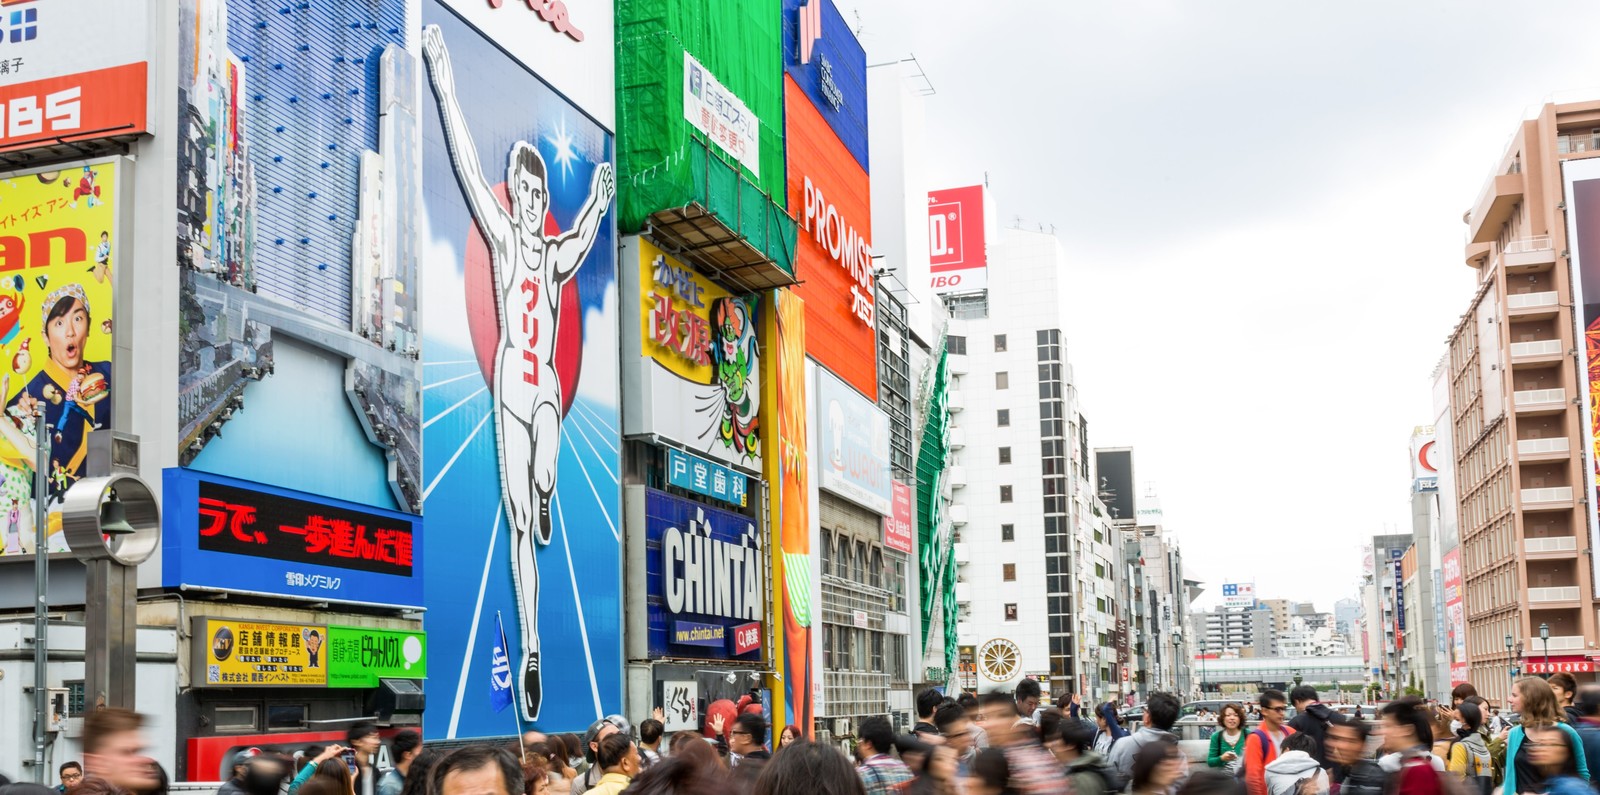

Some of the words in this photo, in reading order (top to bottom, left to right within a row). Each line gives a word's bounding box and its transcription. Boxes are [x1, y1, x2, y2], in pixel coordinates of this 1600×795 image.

[0, 86, 81, 139] BS
[804, 175, 874, 299] PROMISE
[652, 254, 705, 309] かぜに
[520, 275, 540, 387] グリコ
[648, 291, 712, 367] 改源
[674, 454, 745, 501] 戸堂歯科
[285, 571, 341, 591] 雪印メグミルク
[662, 506, 763, 621] CHINTAI
[239, 630, 301, 648] 店舗情報館
[361, 635, 401, 668] ピタットハウス
[222, 673, 249, 682] 株式会社
[251, 673, 290, 683] 関西インベスト
